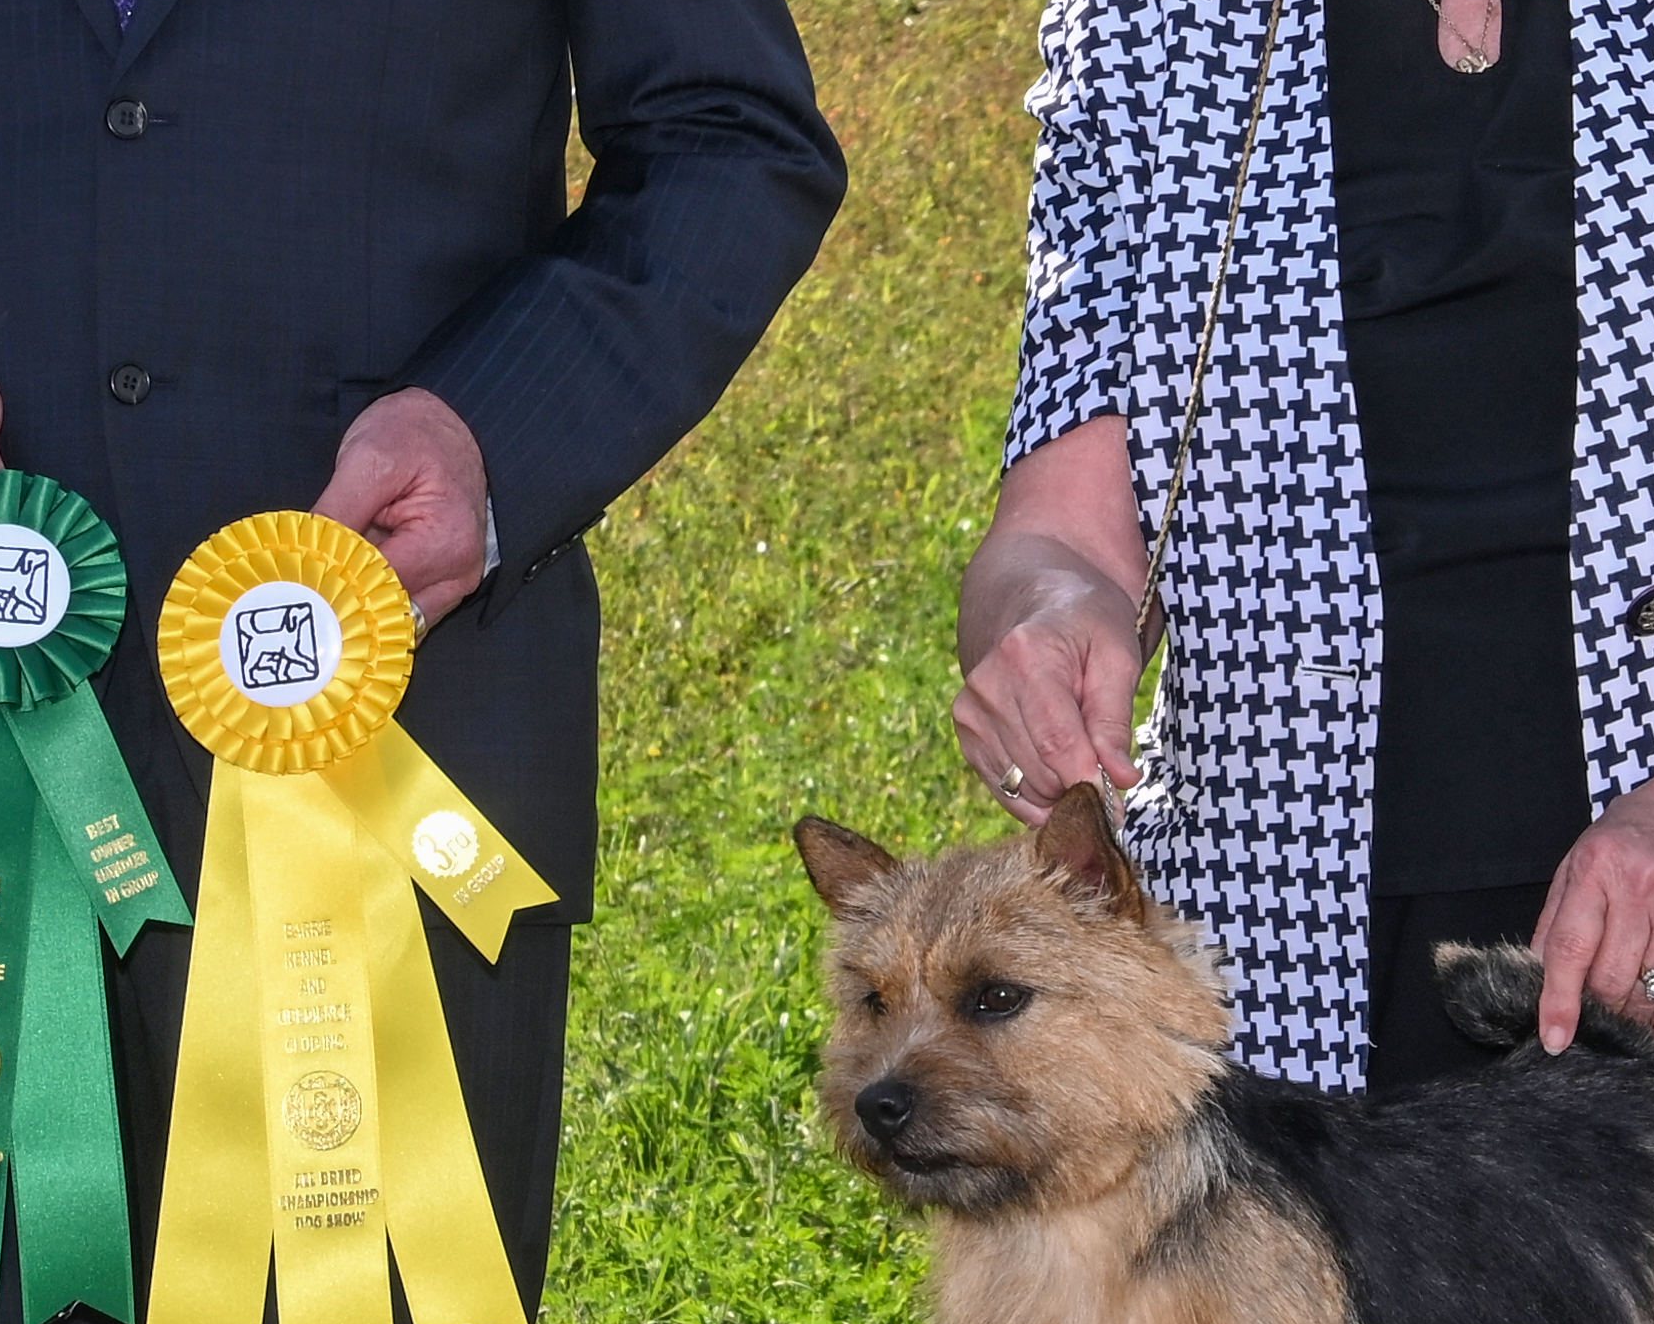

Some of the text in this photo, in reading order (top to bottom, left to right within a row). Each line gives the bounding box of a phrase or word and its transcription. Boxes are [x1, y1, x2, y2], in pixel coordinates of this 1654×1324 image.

[85, 814, 120, 840] BEST
[104, 870, 159, 904] IN GROUP
[466, 854, 506, 893] GROUP
[298, 977, 326, 997] AND
